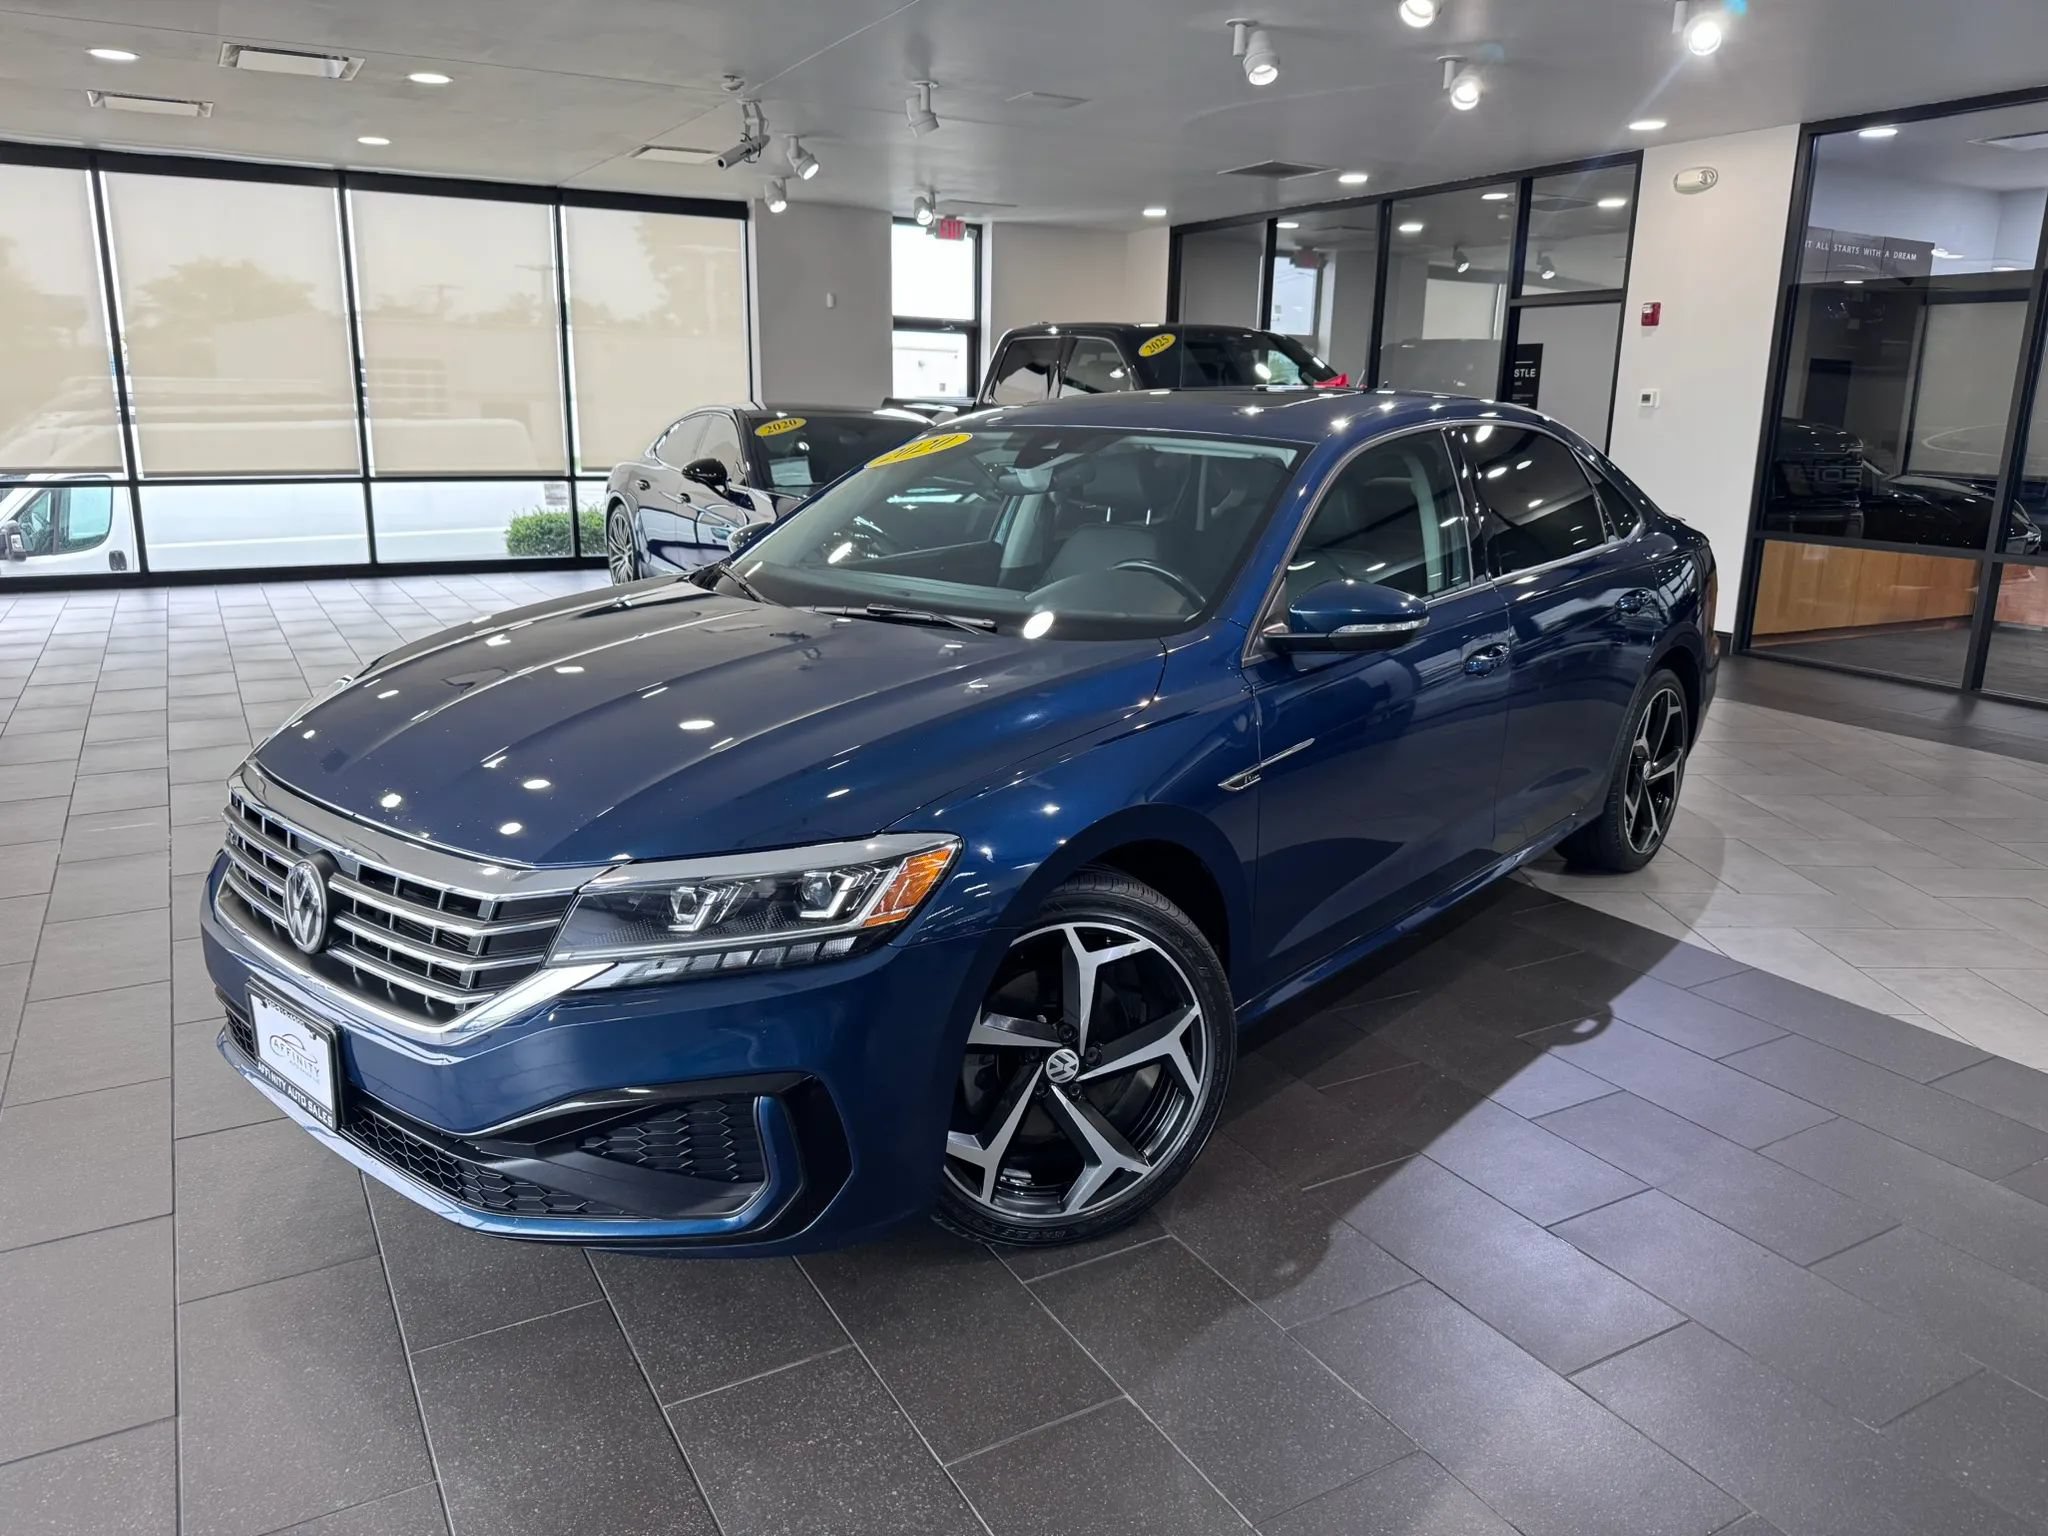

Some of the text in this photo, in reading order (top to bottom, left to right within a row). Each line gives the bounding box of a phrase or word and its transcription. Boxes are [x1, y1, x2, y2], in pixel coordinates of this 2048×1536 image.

[1816, 241, 1829, 251] ALL
[1833, 244, 1859, 254] STARTS
[1863, 247, 1881, 257] WITH
[1893, 251, 1917, 260] DREAM
[1145, 335, 1170, 353] 2025
[766, 417, 797, 434] 2020
[273, 1039, 320, 1078] AFFINITY
[257, 1061, 287, 1091] AFFINITY
[288, 1084, 307, 1108] AUTO
[307, 1101, 333, 1128] SALES
